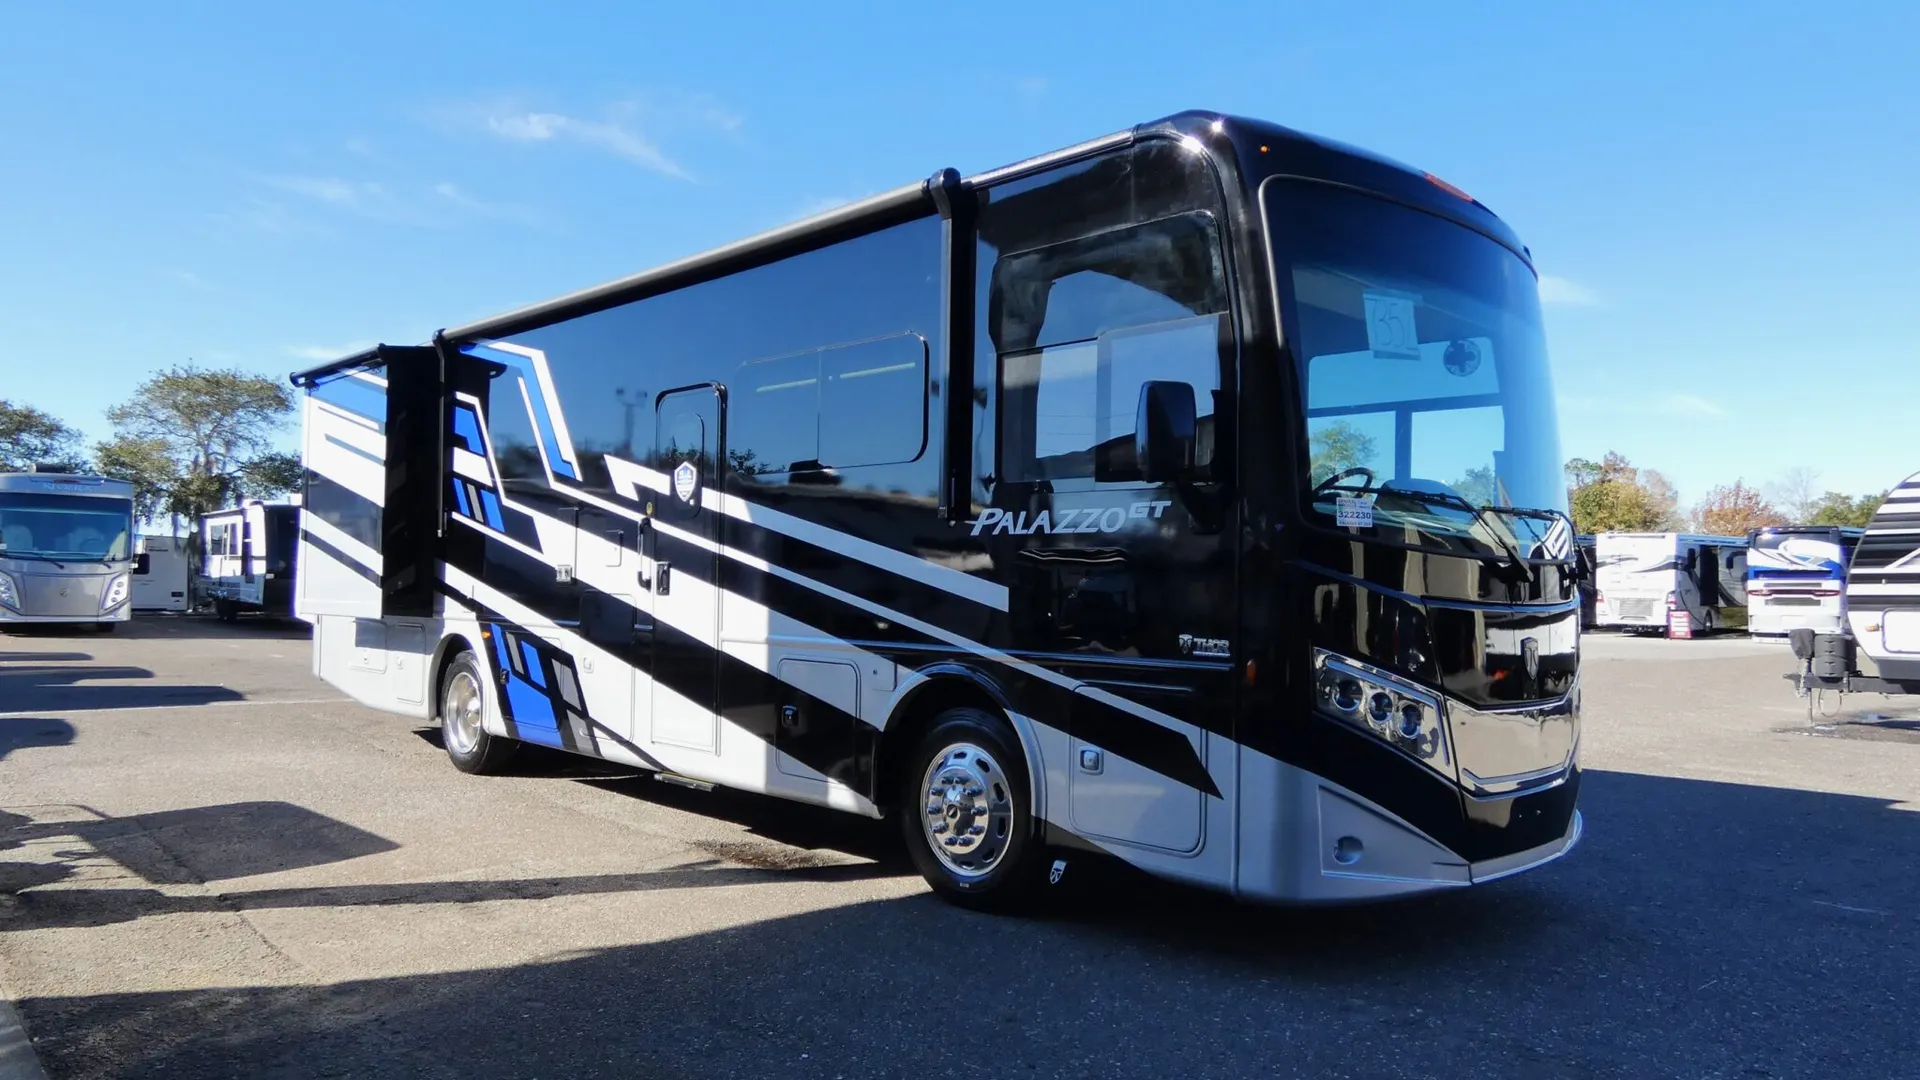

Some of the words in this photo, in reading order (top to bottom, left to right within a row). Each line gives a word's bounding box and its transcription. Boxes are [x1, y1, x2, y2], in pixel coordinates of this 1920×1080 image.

[964, 507, 1126, 536] PALAZZO
[1128, 500, 1172, 518] GT
[1338, 510, 1371, 519] 322230
